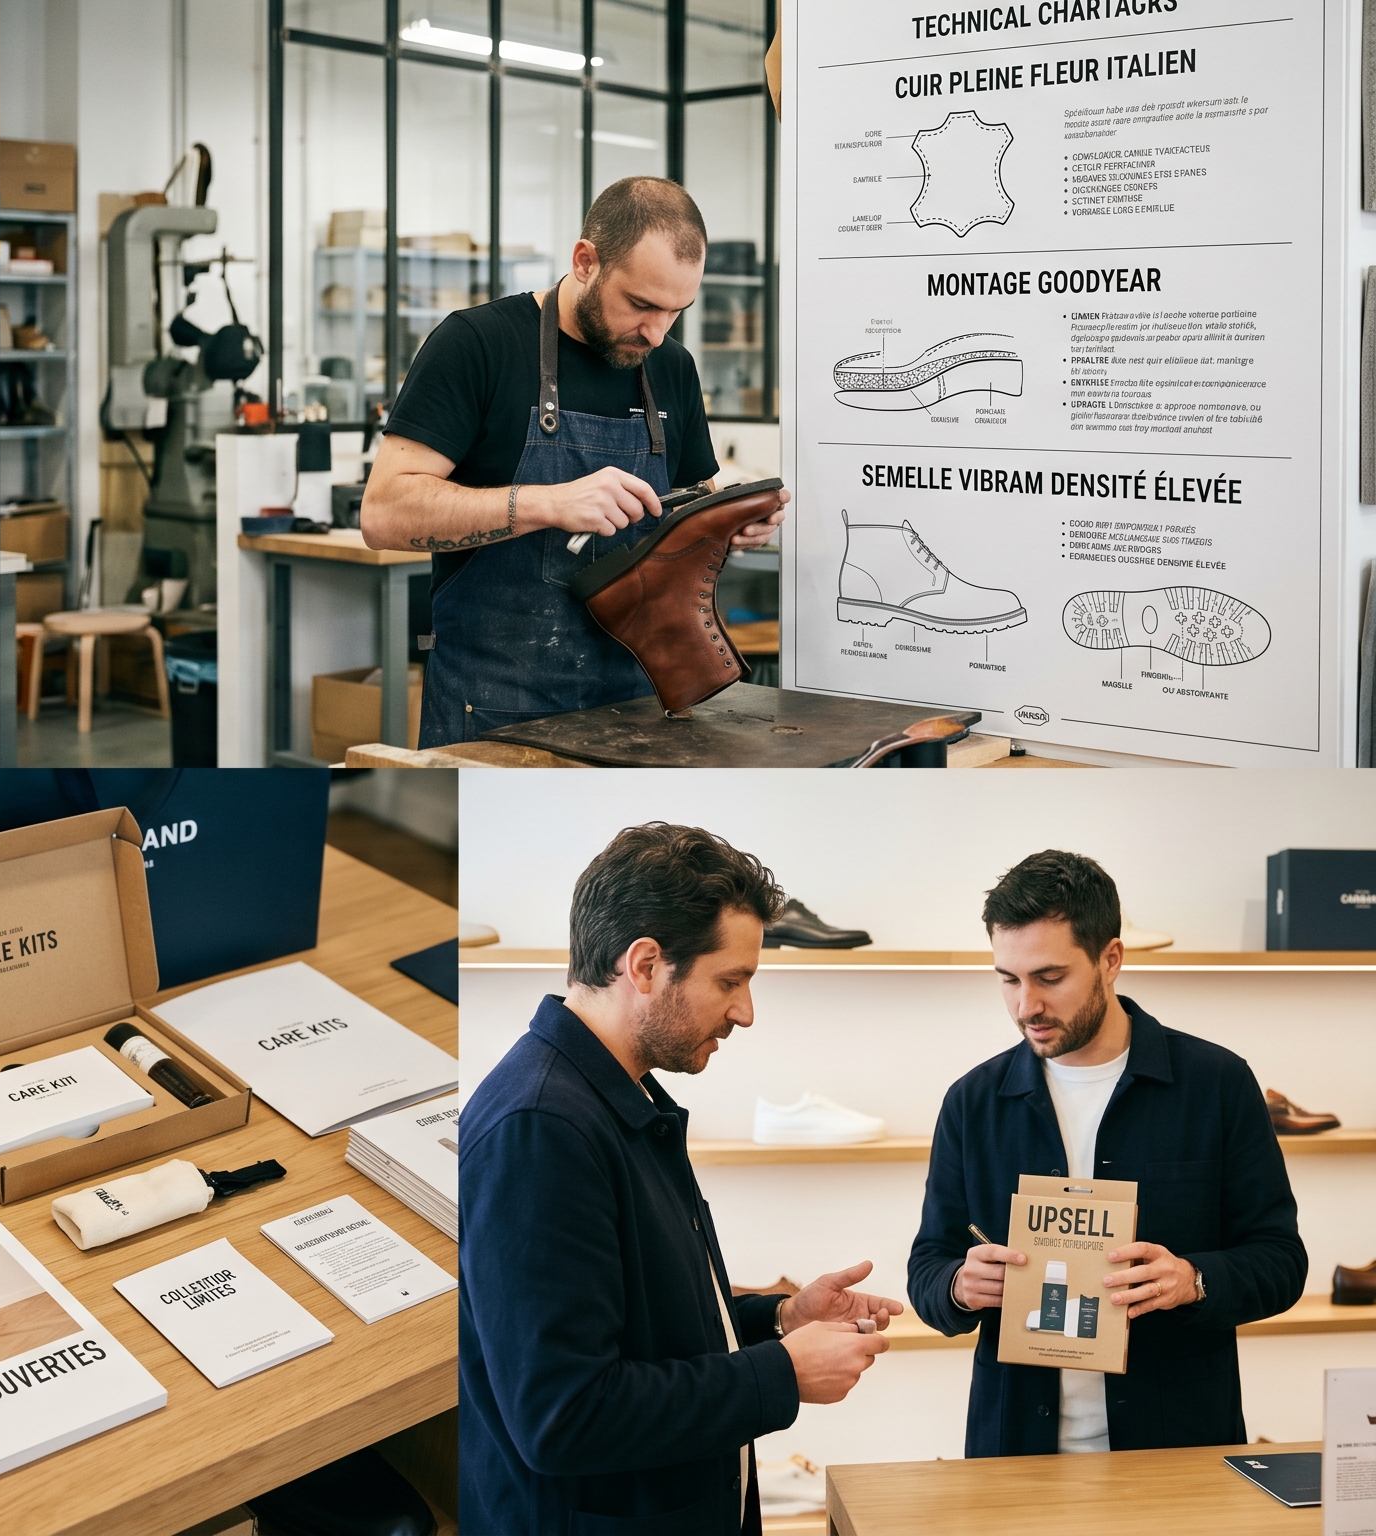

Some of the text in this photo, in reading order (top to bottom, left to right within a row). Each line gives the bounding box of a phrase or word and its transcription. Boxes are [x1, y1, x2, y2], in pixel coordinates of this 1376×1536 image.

[912, 1, 1031, 39] TECHNICAL
[895, 48, 1197, 99] CUIR PLEINE FLEUR ITALIEN
[927, 267, 1162, 297] MONTAGE GOODYEAR
[862, 464, 1242, 504] SEMELLE VIBRAM DENSITÉ ÉLEVÉE
[142, 819, 198, 852] AND
[19, 930, 58, 957] KITS
[258, 1017, 348, 1051] CARE KITS
[8, 1083, 49, 1102] CARE
[1028, 1204, 1115, 1238] UPSELL
